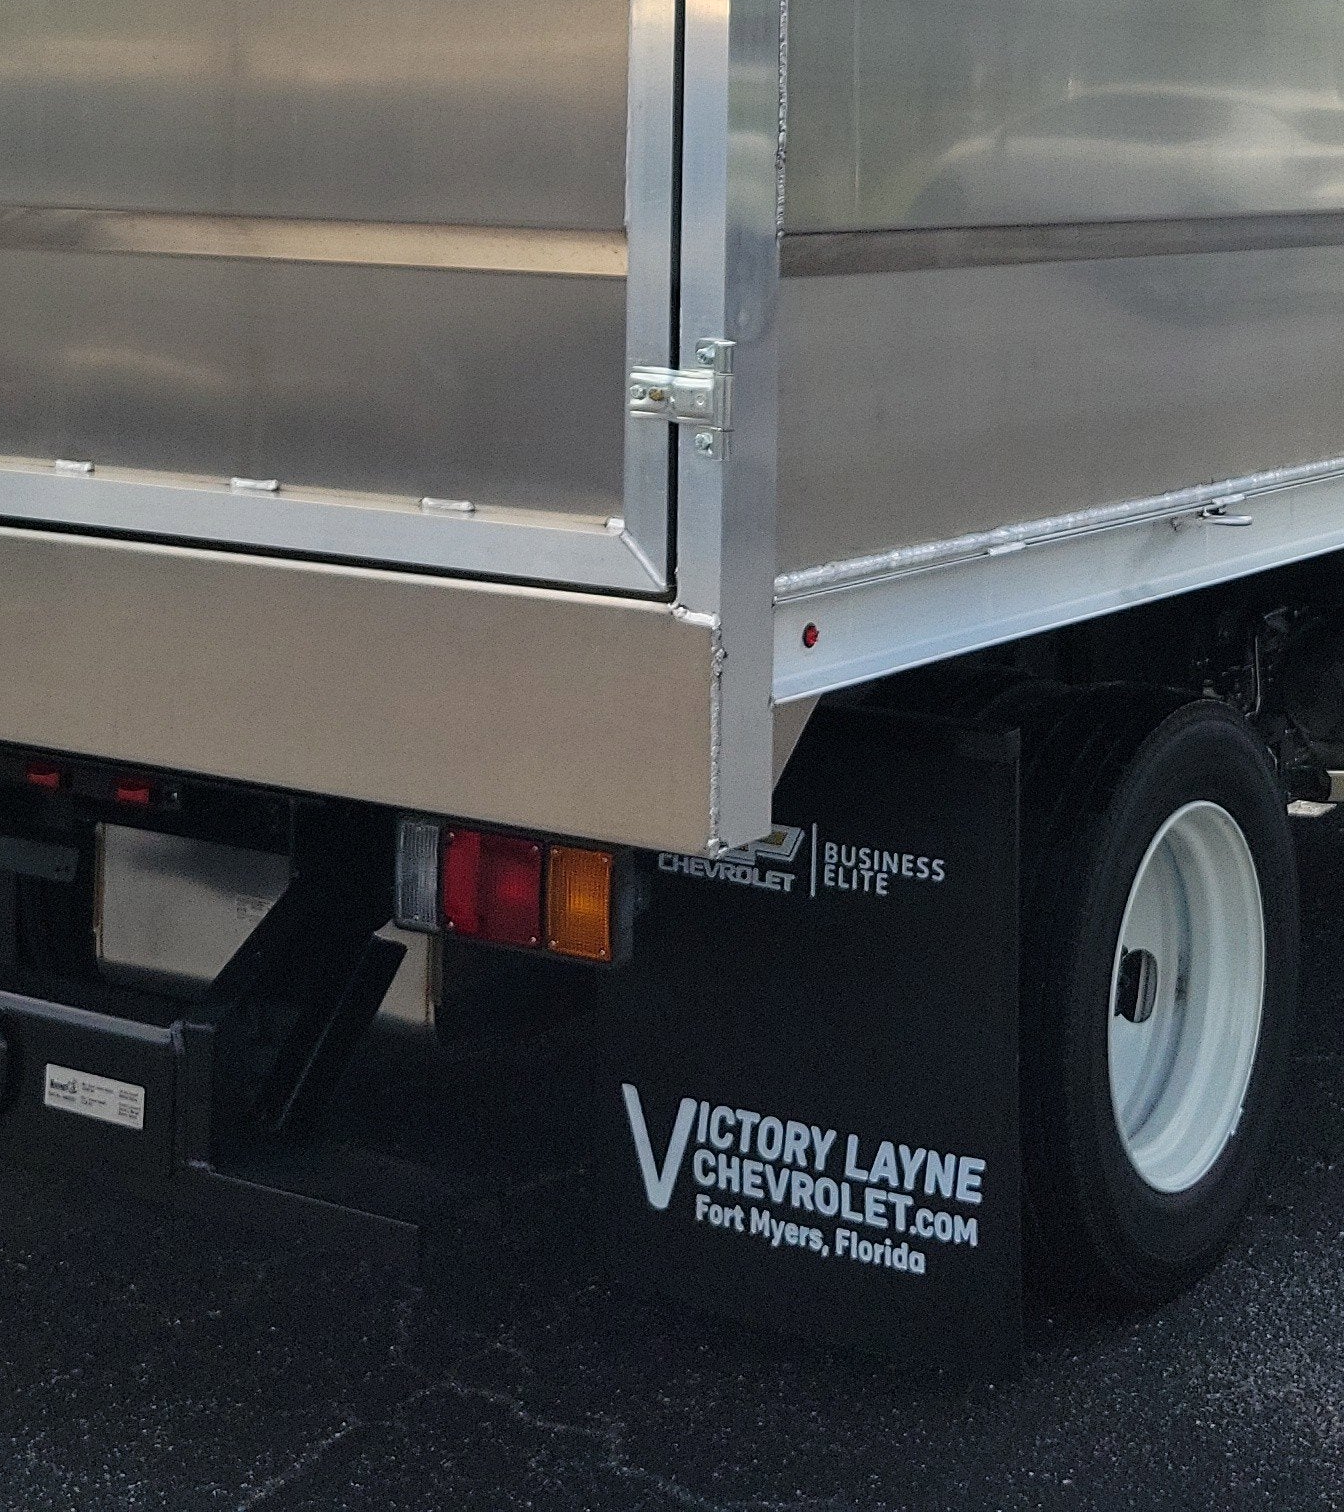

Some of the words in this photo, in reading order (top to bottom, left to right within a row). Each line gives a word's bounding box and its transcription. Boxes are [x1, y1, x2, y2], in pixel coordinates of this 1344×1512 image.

[658, 852, 796, 892] CHEVROLET
[823, 863, 889, 895] ELITE
[824, 841, 946, 882] BUSINESS
[622, 1083, 837, 1209] VICTORY
[845, 1134, 987, 1204] LAYNE
[693, 1148, 978, 1248] CHEVROLET.COM
[695, 1194, 744, 1232] Fort
[750, 1206, 829, 1257] Myers,
[835, 1228, 927, 1275] Florida
